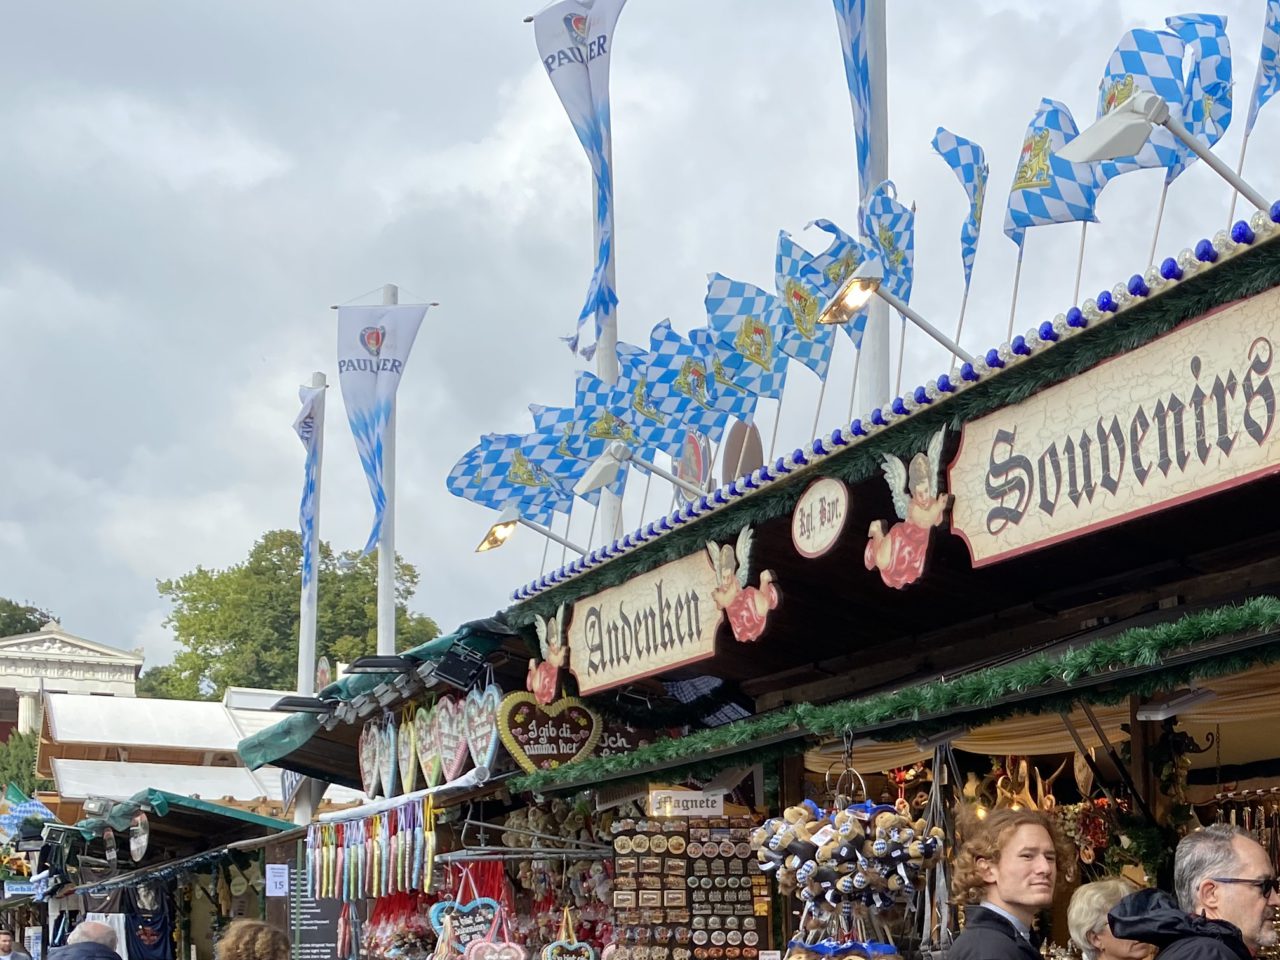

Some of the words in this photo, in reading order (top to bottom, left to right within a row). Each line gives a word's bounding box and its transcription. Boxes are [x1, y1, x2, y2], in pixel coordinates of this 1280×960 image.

[543, 34, 608, 76] PAUER
[985, 337, 1276, 536] Souvenirs
[584, 579, 703, 678] Andenken
[523, 740, 557, 756] nimma
[559, 738, 580, 754] her
[538, 721, 557, 744] gib
[559, 722, 571, 738] di
[274, 880, 284, 890] 15
